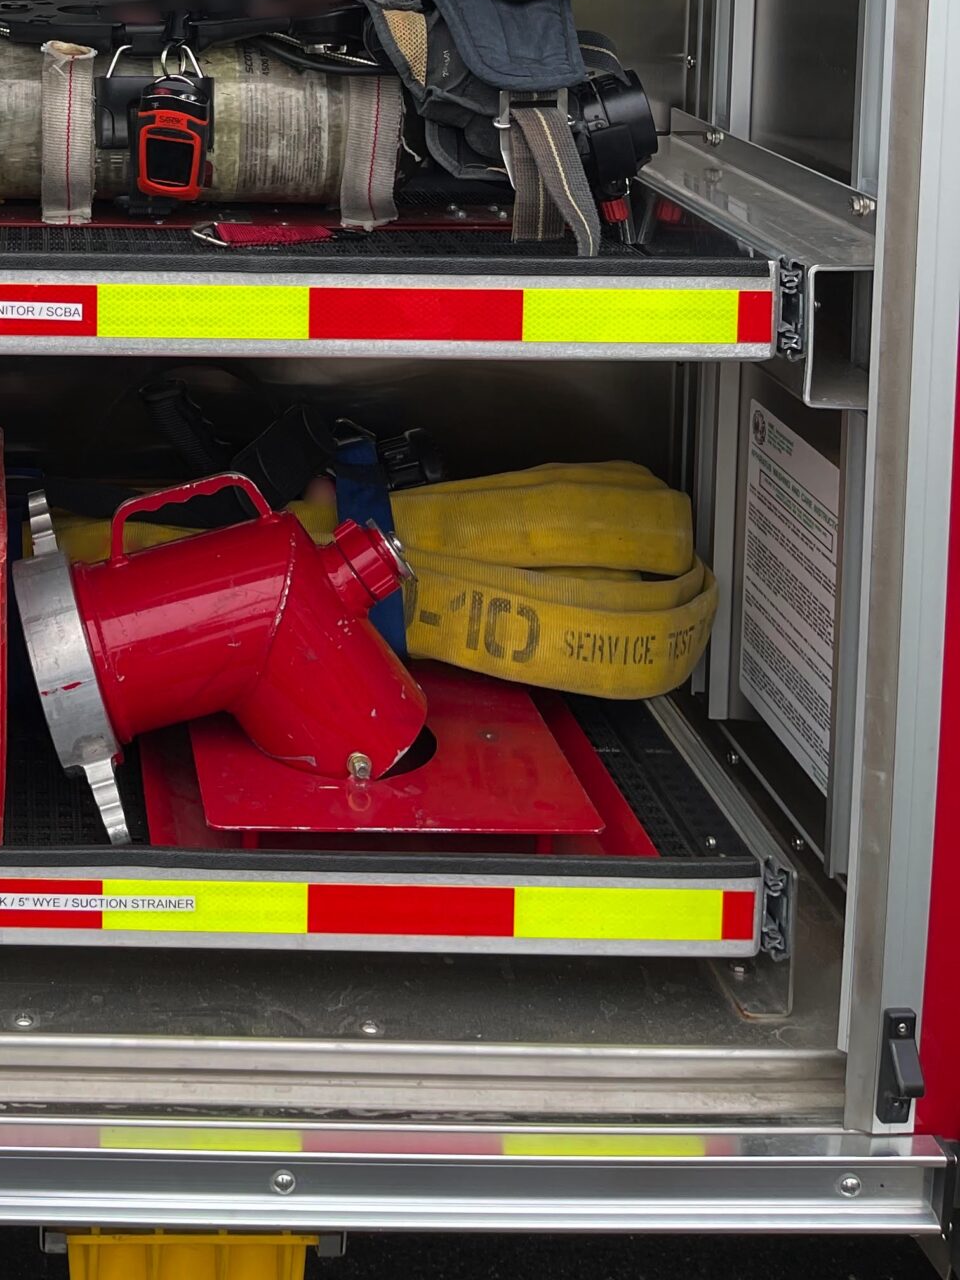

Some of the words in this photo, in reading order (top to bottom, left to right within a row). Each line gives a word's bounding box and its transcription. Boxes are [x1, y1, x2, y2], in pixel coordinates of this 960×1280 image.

[45, 306, 81, 318] SCBA
[563, 629, 656, 666] SERVICE
[667, 625, 695, 660] TEST
[18, 897, 30, 908] 5"
[31, 897, 61, 908] WYE
[71, 898, 128, 909] SUCTION
[130, 898, 195, 910] STRAINER
